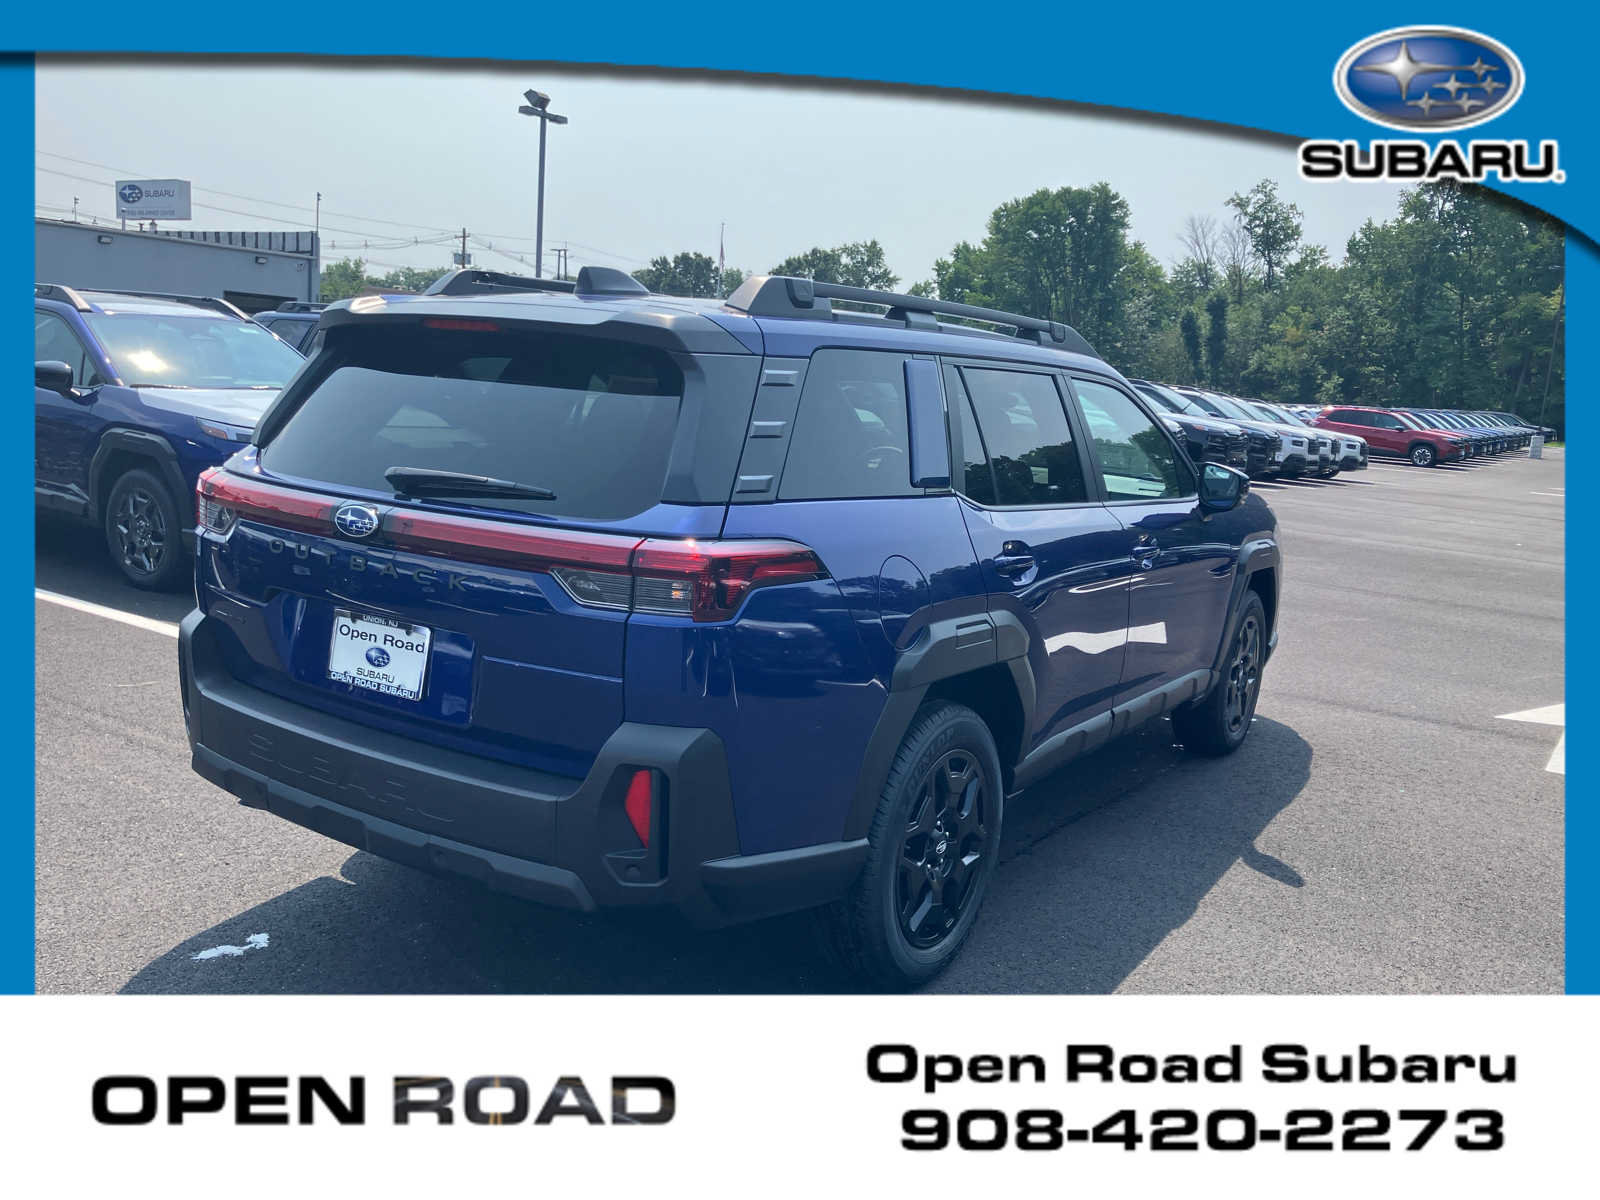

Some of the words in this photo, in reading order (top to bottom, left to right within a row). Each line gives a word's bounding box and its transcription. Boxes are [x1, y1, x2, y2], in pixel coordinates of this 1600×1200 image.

[144, 189, 175, 198] SUBARU
[268, 538, 468, 592] OUTBACK
[388, 619, 399, 628] NJ
[339, 624, 377, 643] Open
[383, 633, 425, 654] Road
[330, 672, 353, 684] OPEN
[354, 678, 378, 690] ROAD
[379, 684, 415, 699] SUBARU
[356, 667, 395, 683] SUBARU
